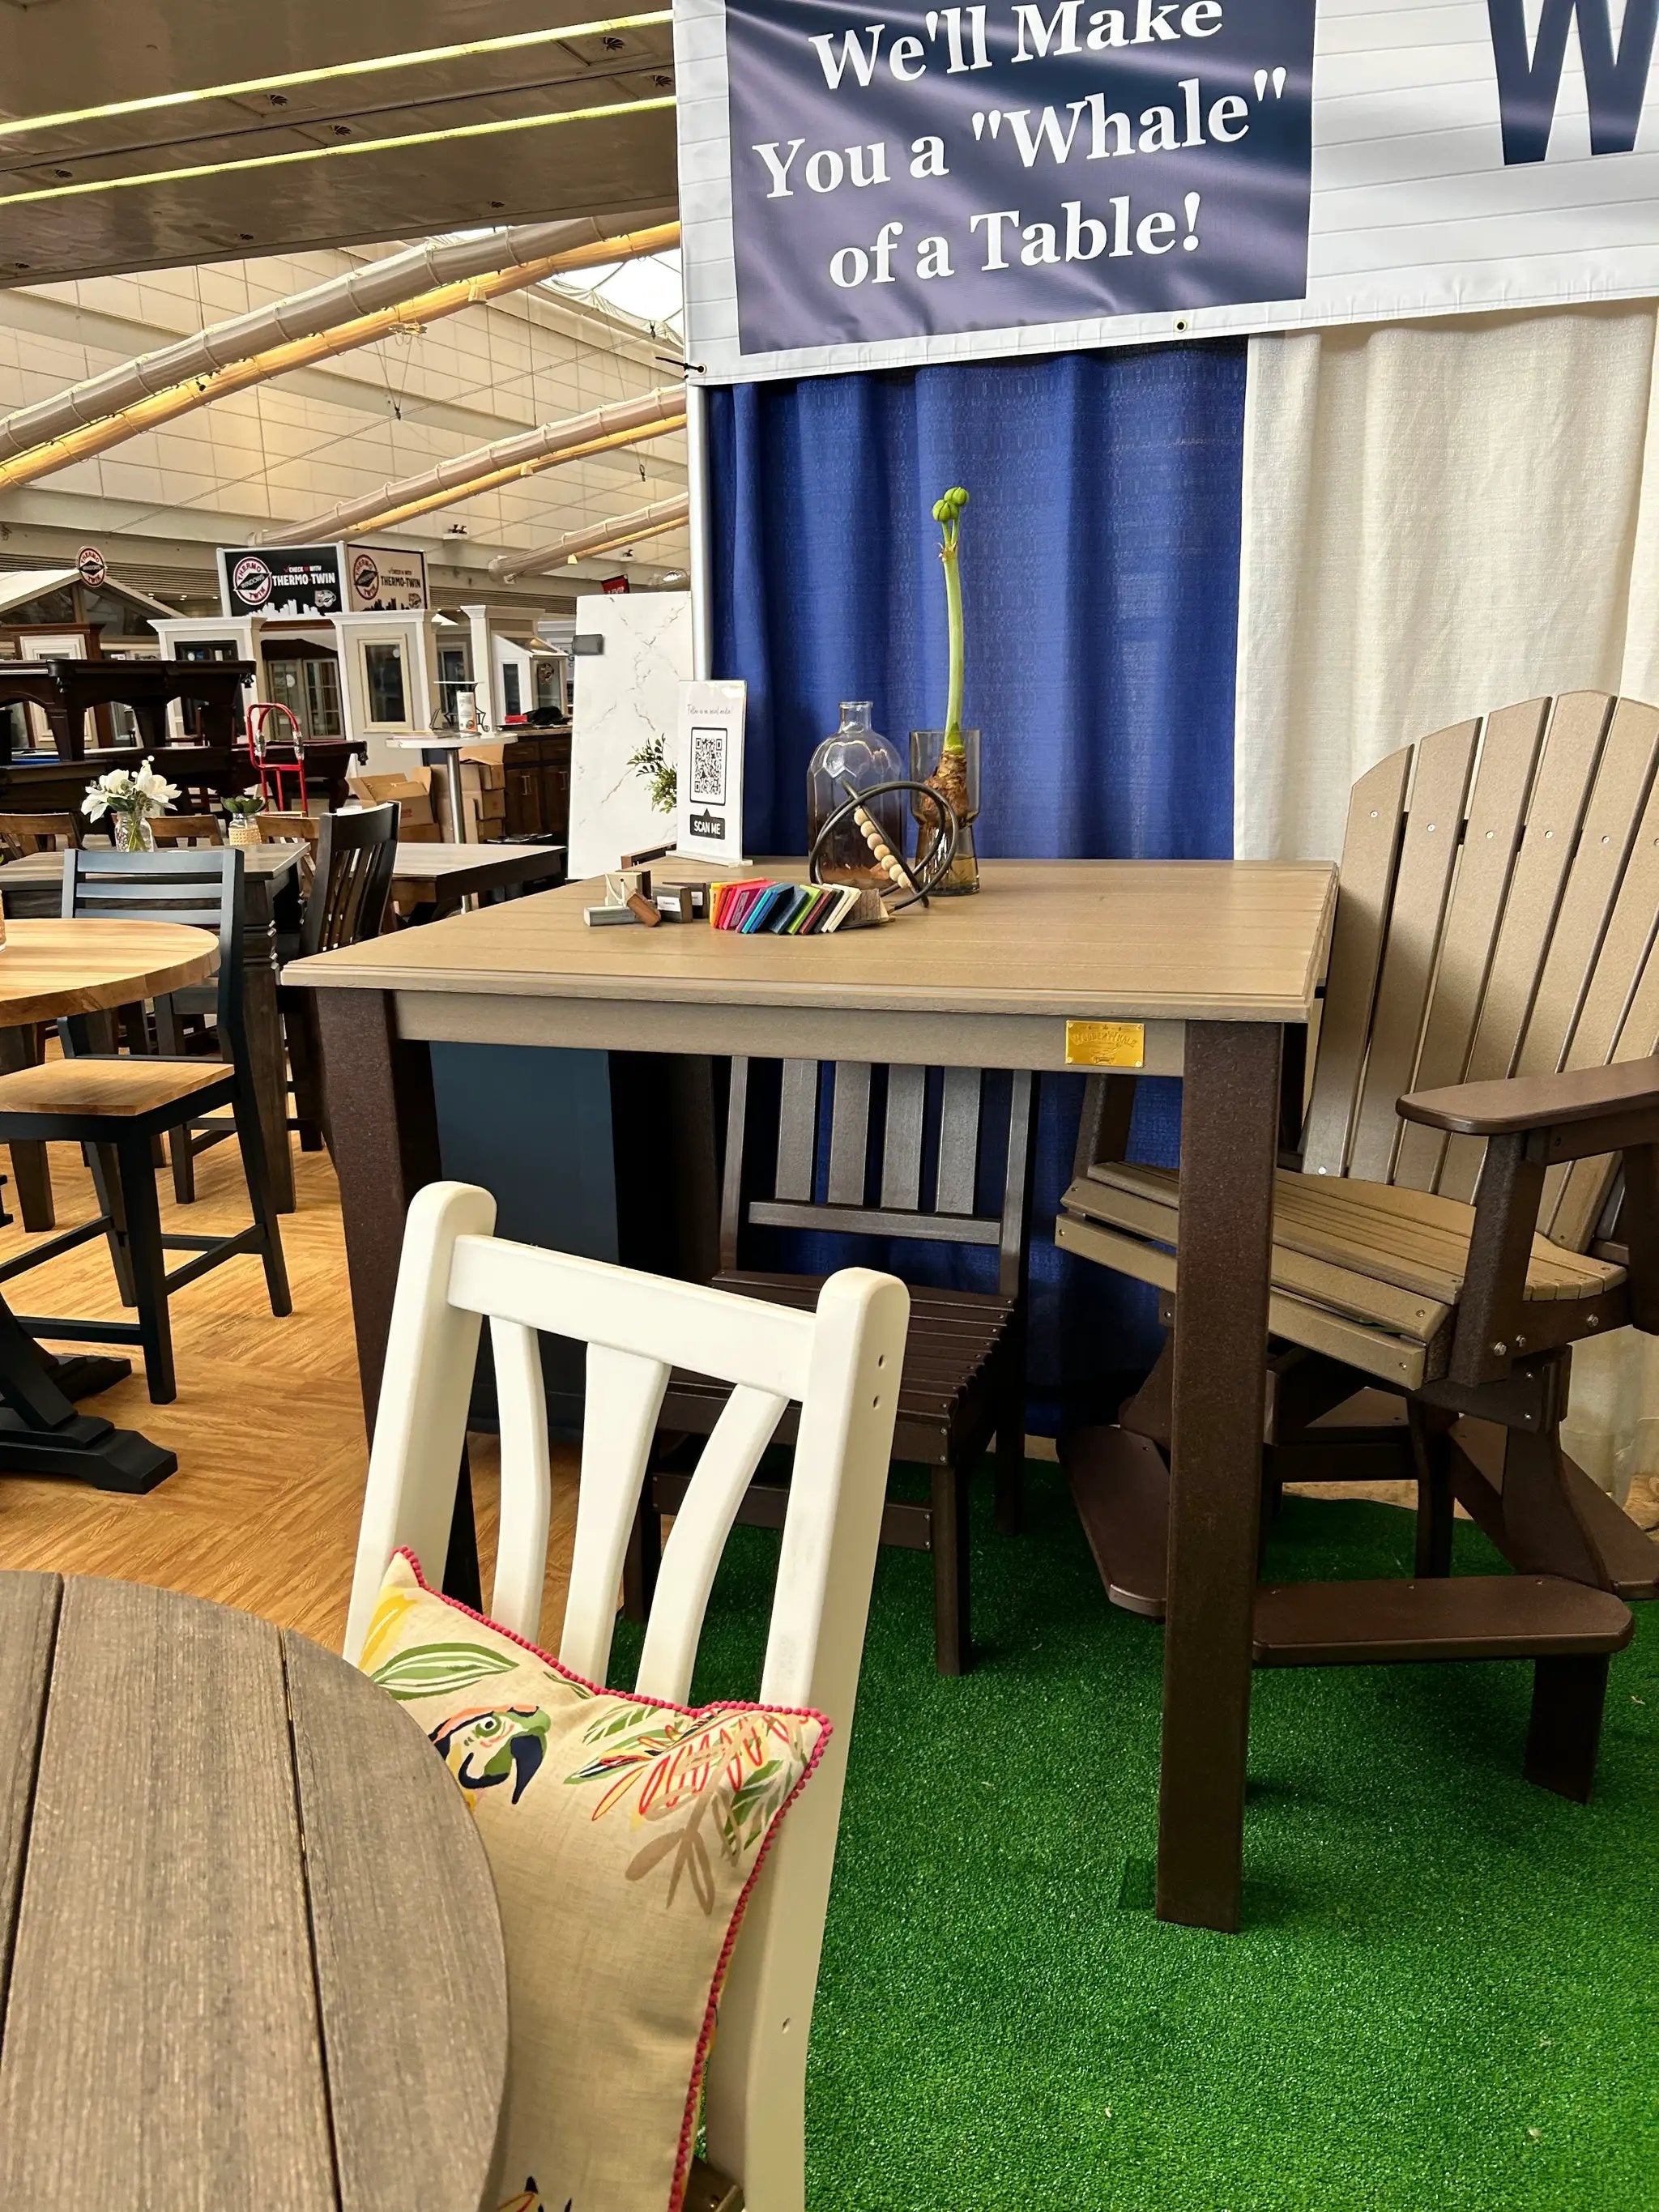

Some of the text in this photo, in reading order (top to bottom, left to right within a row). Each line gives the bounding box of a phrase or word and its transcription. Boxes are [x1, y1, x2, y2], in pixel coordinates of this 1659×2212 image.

[808, 0, 1223, 90] We'll Make
[753, 67, 1287, 199] You a "Whale"
[829, 191, 1201, 288] of a Table!
[237, 561, 262, 580] THERMO
[249, 587, 267, 600] TWIN
[693, 820, 721, 835] SCAN ME
